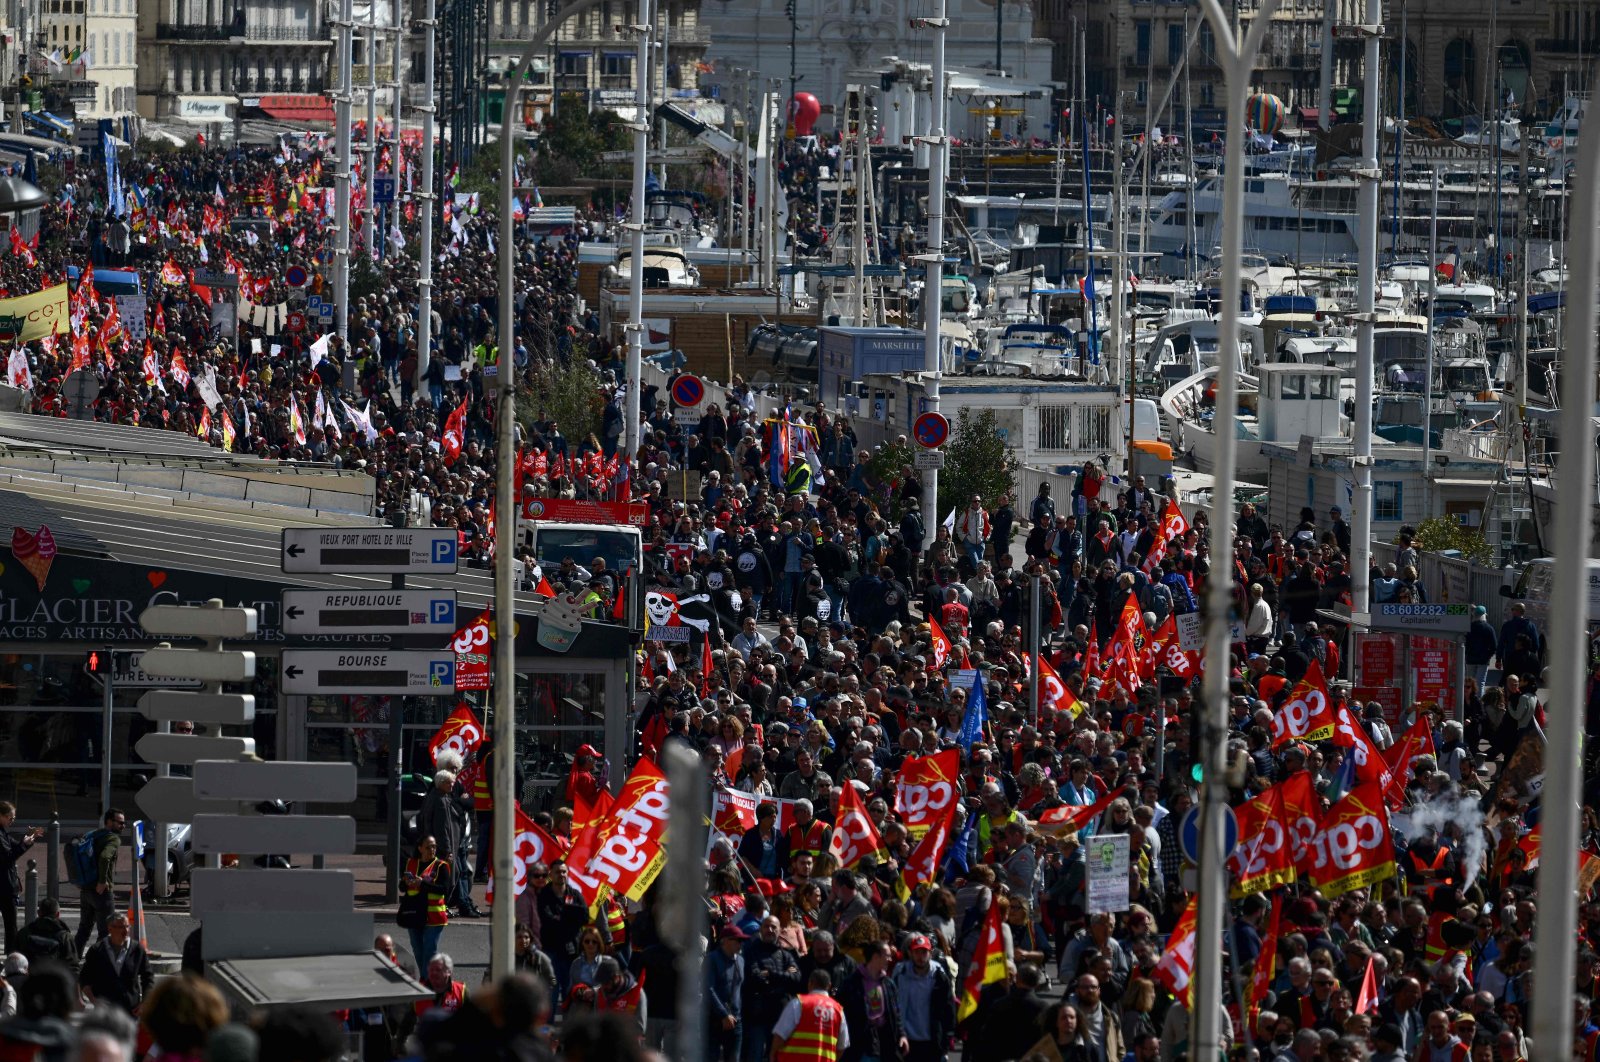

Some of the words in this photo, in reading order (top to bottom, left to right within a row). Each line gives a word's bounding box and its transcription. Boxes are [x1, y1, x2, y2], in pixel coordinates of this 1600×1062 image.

[28, 301, 65, 322] CGT
[872, 342, 921, 350] MARSEILLE
[629, 514, 645, 525] cgt
[320, 534, 339, 544] VIEUX
[342, 534, 359, 544] PORT
[362, 534, 382, 544] HOTEL
[384, 534, 393, 544] DE
[396, 534, 413, 544] VILLE
[436, 542, 450, 562] P
[0, 589, 137, 623] LACIER
[326, 595, 402, 606] REPUBLIQUE
[434, 602, 449, 621] P
[1383, 605, 1396, 615] 83
[1398, 606, 1412, 615] 60
[1448, 605, 1467, 614] 582
[1400, 616, 1441, 624] Capitainerie
[338, 656, 388, 666] BOURSE
[434, 664, 449, 683] P
[814, 1002, 835, 1022] cgt
